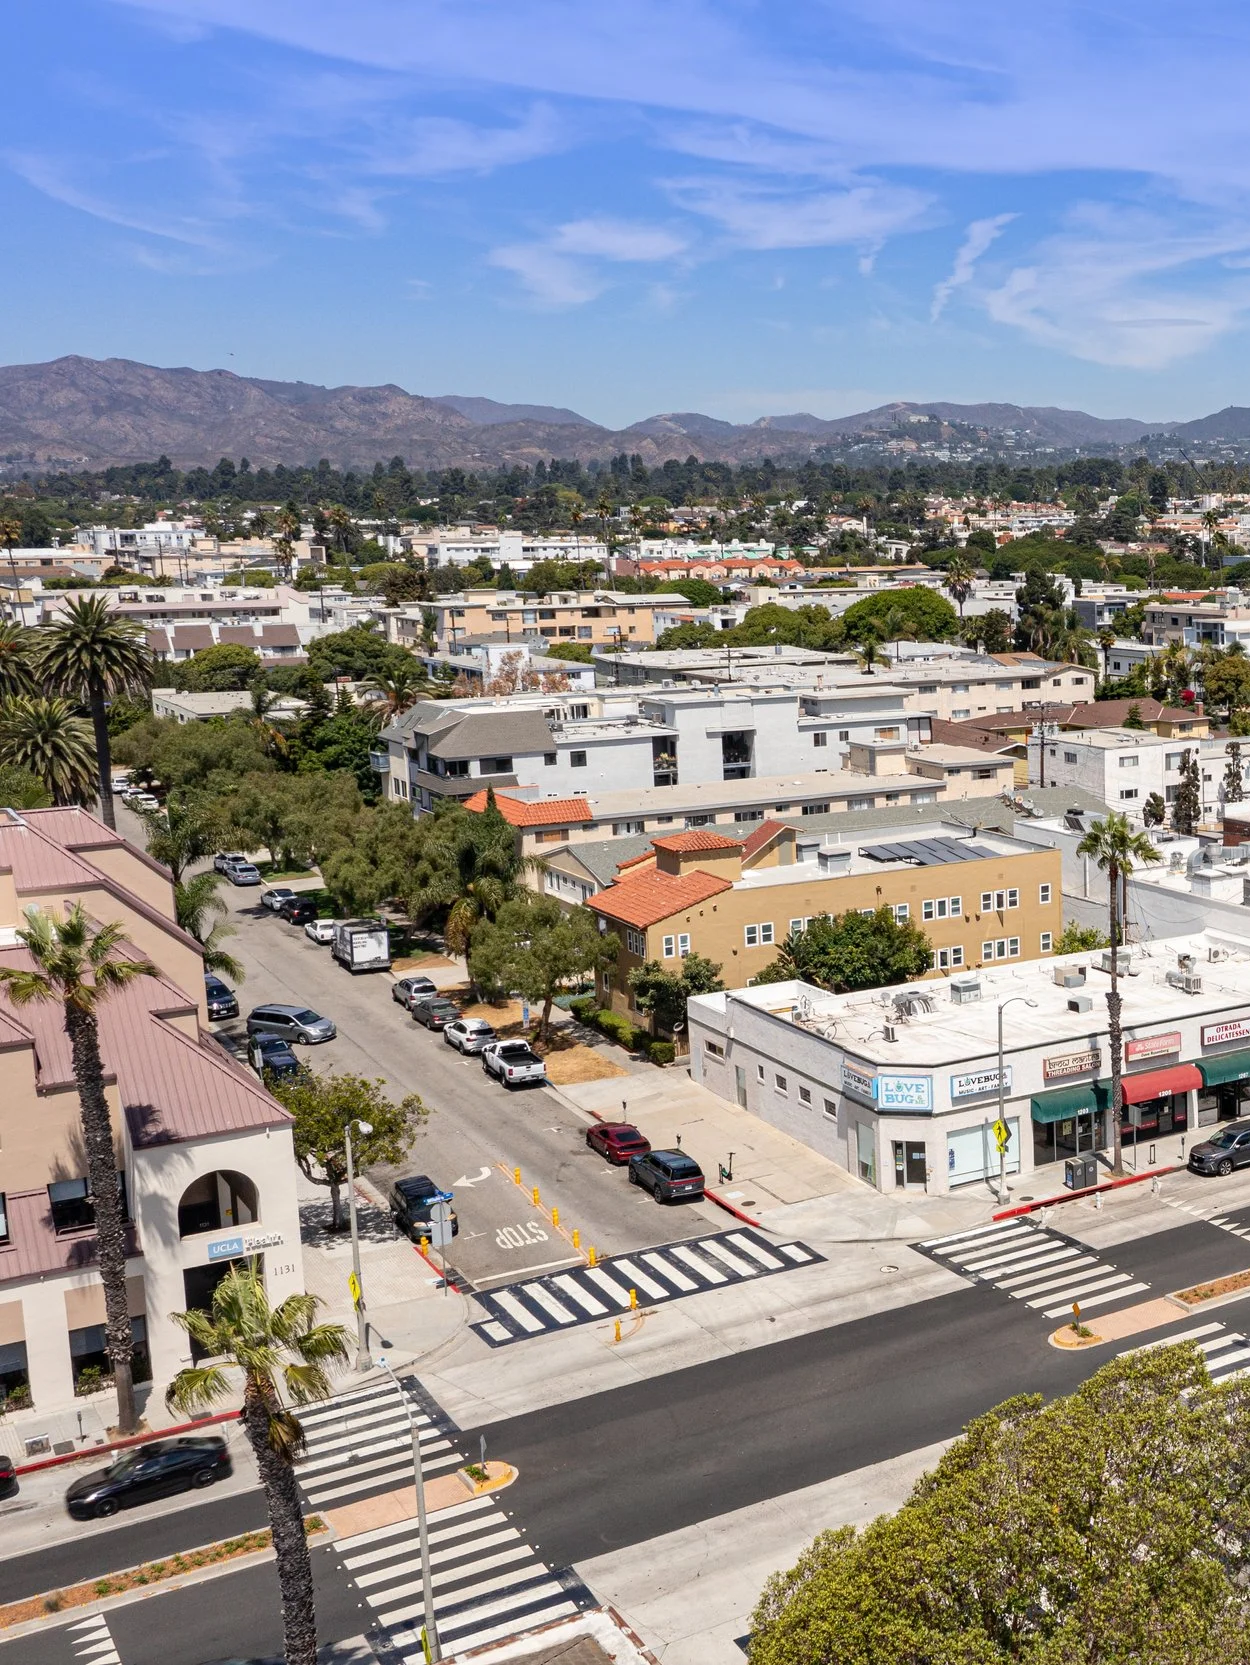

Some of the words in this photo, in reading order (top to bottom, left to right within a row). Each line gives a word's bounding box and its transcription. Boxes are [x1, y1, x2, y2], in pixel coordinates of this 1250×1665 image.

[1216, 1023, 1241, 1034] OTRADA
[1207, 1029, 1250, 1043] DELICATESSEN
[1048, 1066, 1081, 1077] THREADING
[1081, 1062, 1100, 1070] SALON
[885, 1080, 925, 1093] LOVE
[885, 1094, 914, 1104] BUG
[495, 1221, 549, 1249] STOP
[212, 1242, 239, 1254] UCLA
[274, 1263, 295, 1276] 1131
